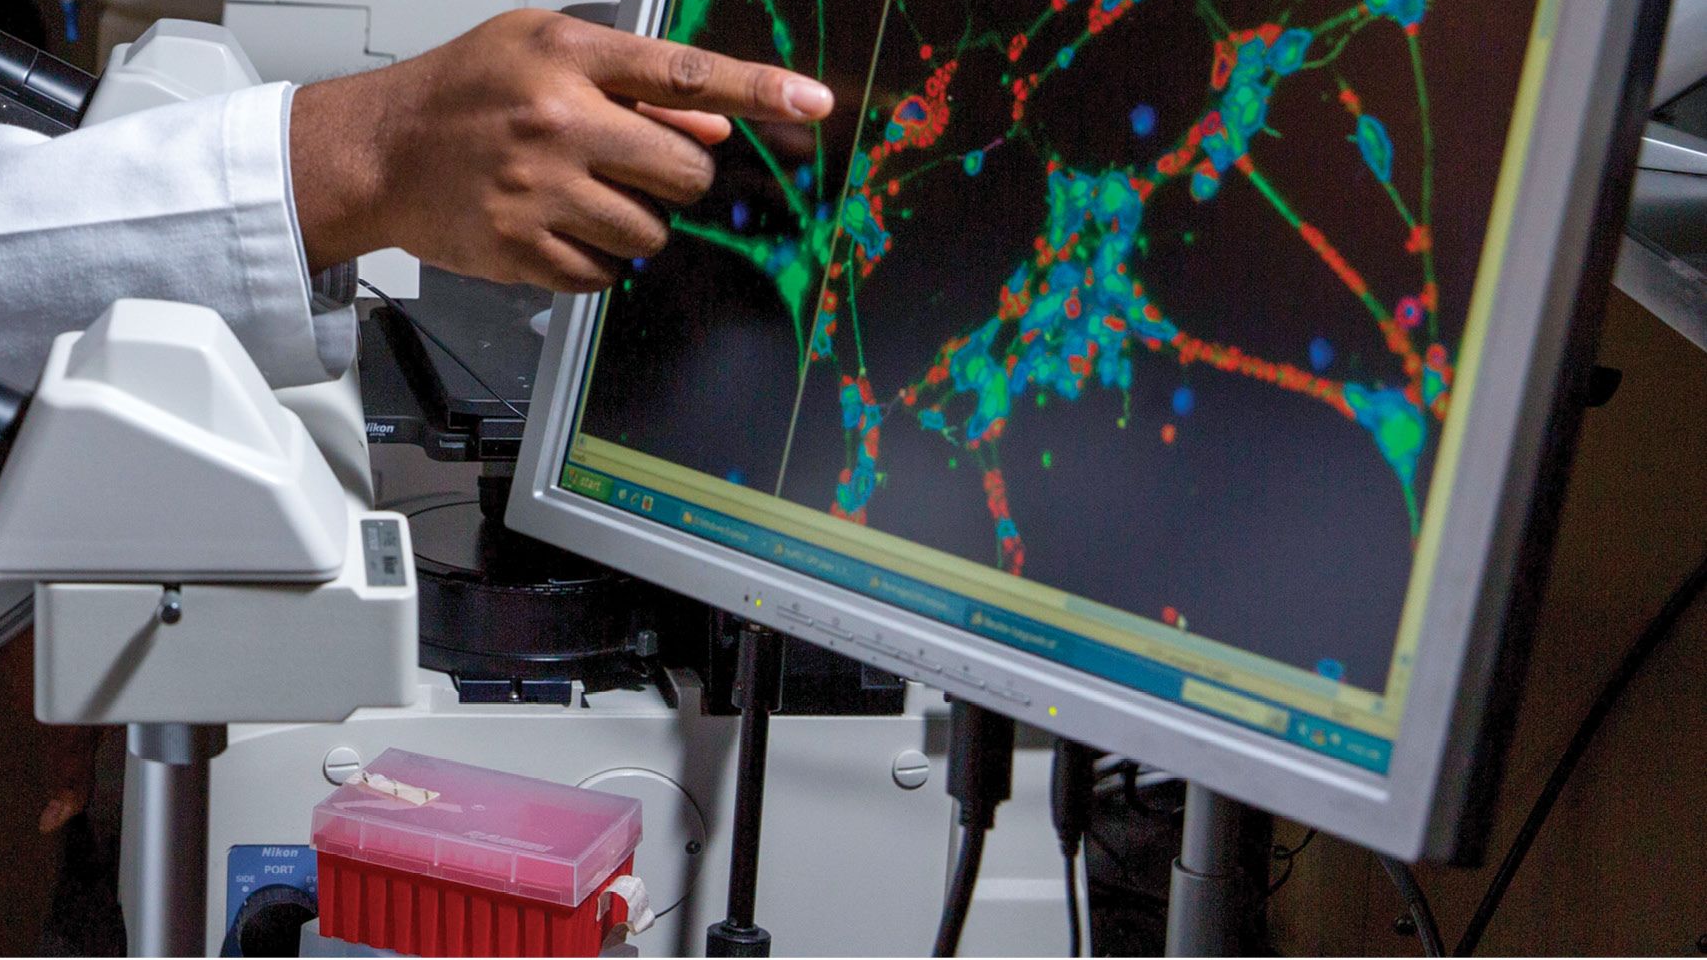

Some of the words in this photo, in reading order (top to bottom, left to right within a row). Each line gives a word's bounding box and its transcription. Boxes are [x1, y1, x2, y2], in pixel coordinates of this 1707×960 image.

[261, 847, 299, 858] Nikon
[264, 865, 295, 874] PORT
[235, 874, 256, 883] SIDE
